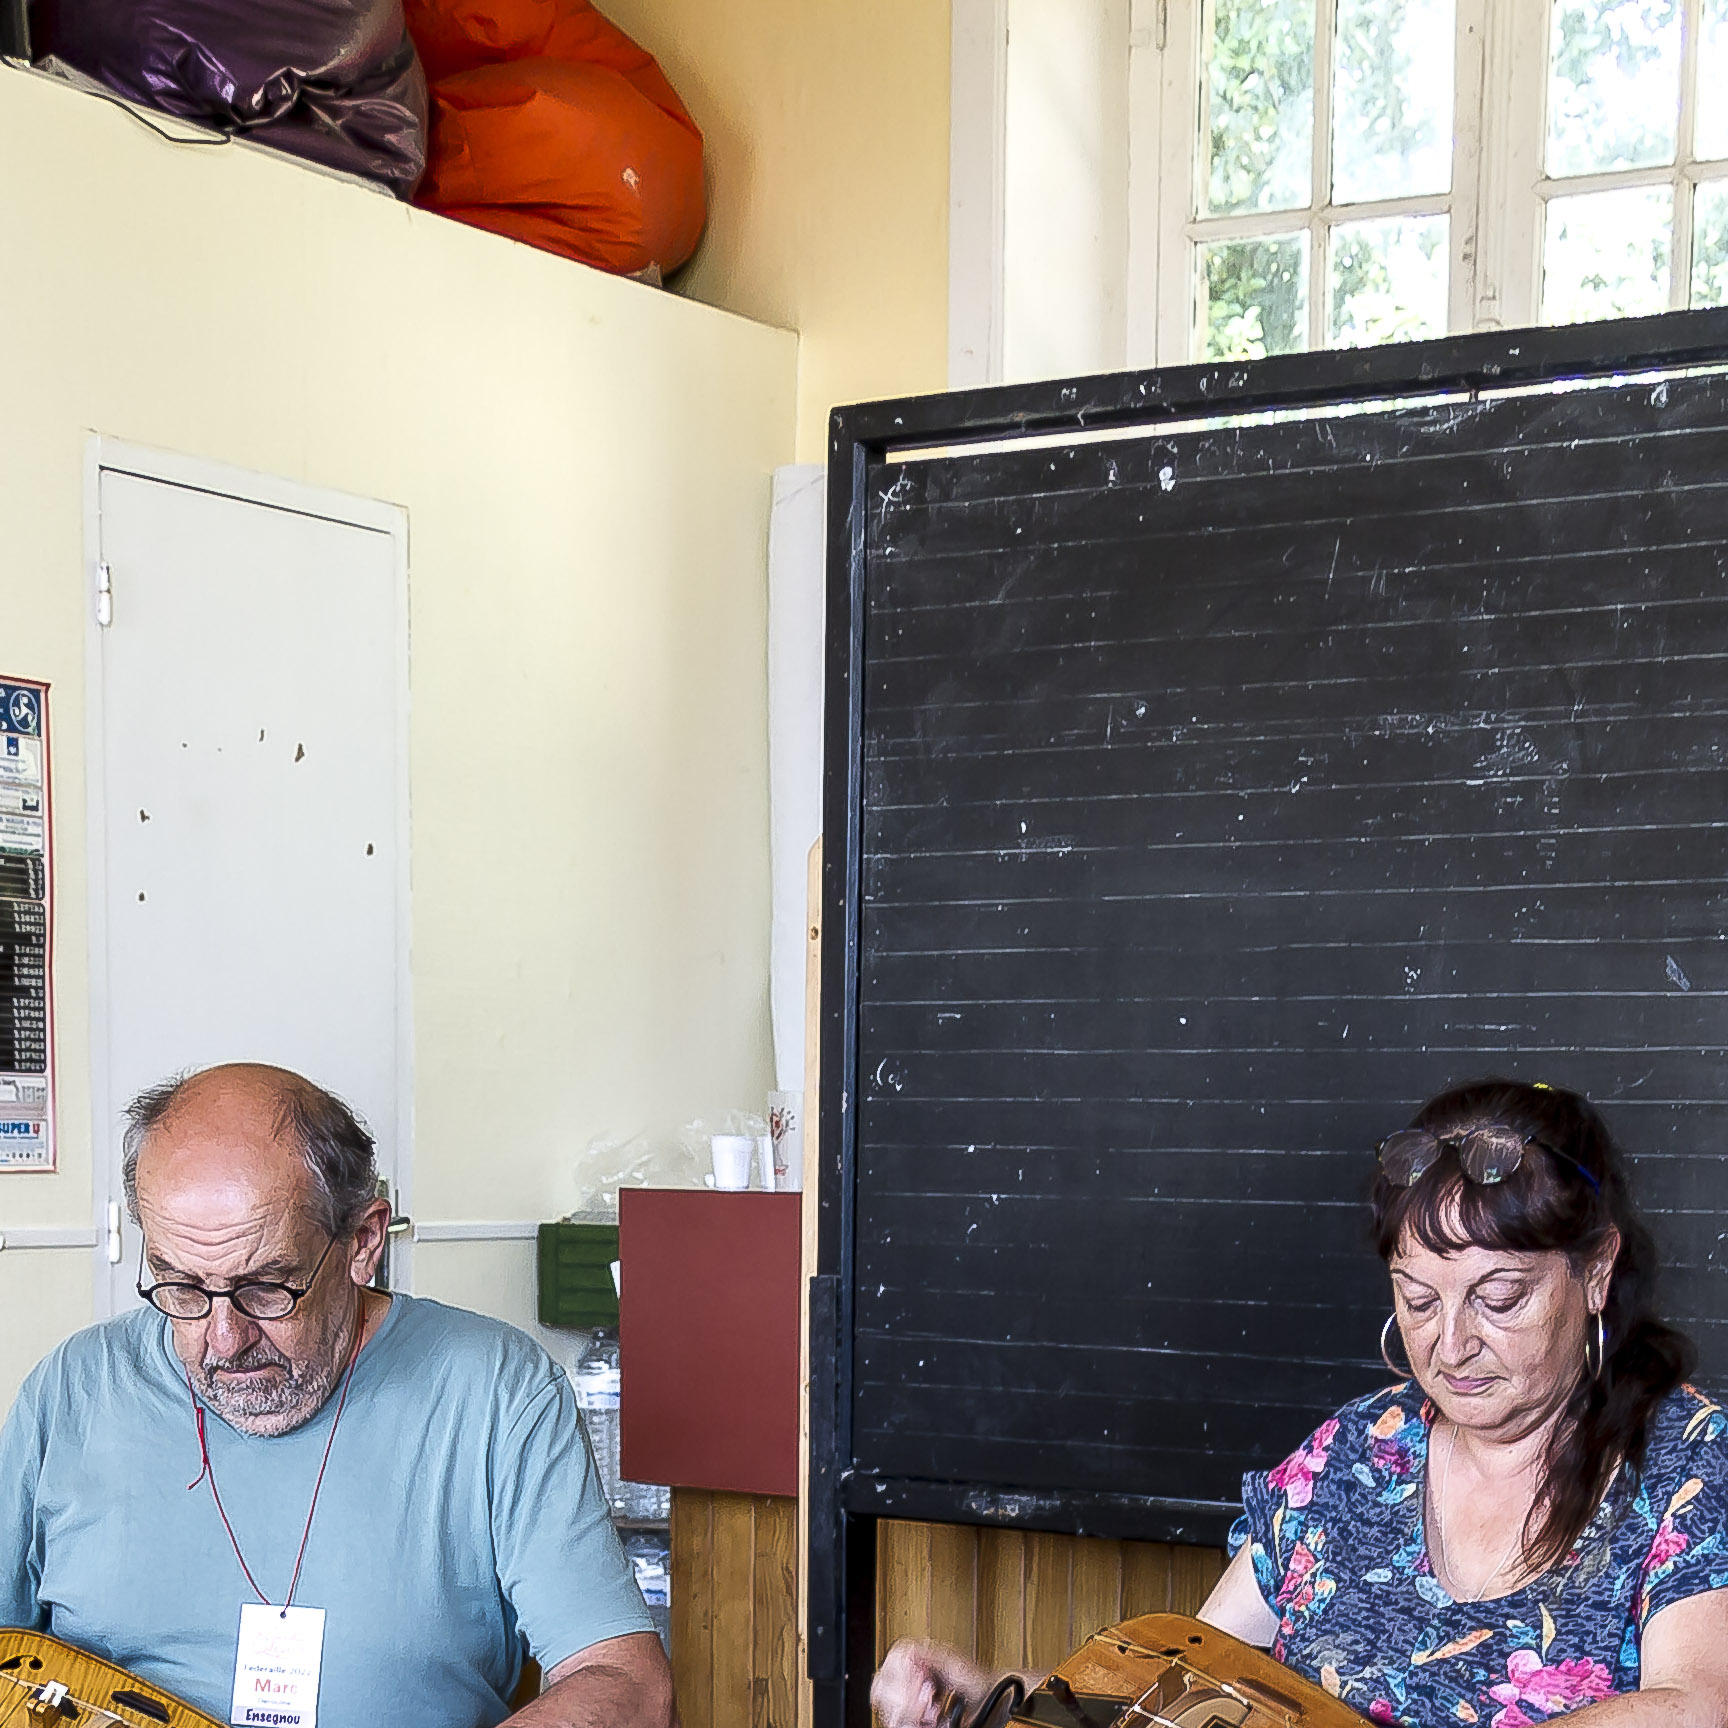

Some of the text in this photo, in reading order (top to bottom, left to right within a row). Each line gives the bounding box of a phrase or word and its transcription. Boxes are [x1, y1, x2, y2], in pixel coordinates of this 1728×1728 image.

[32, 1122, 41, 1134] U
[254, 1678, 298, 1695] Marc
[245, 1708, 301, 1726] Ensegnou
